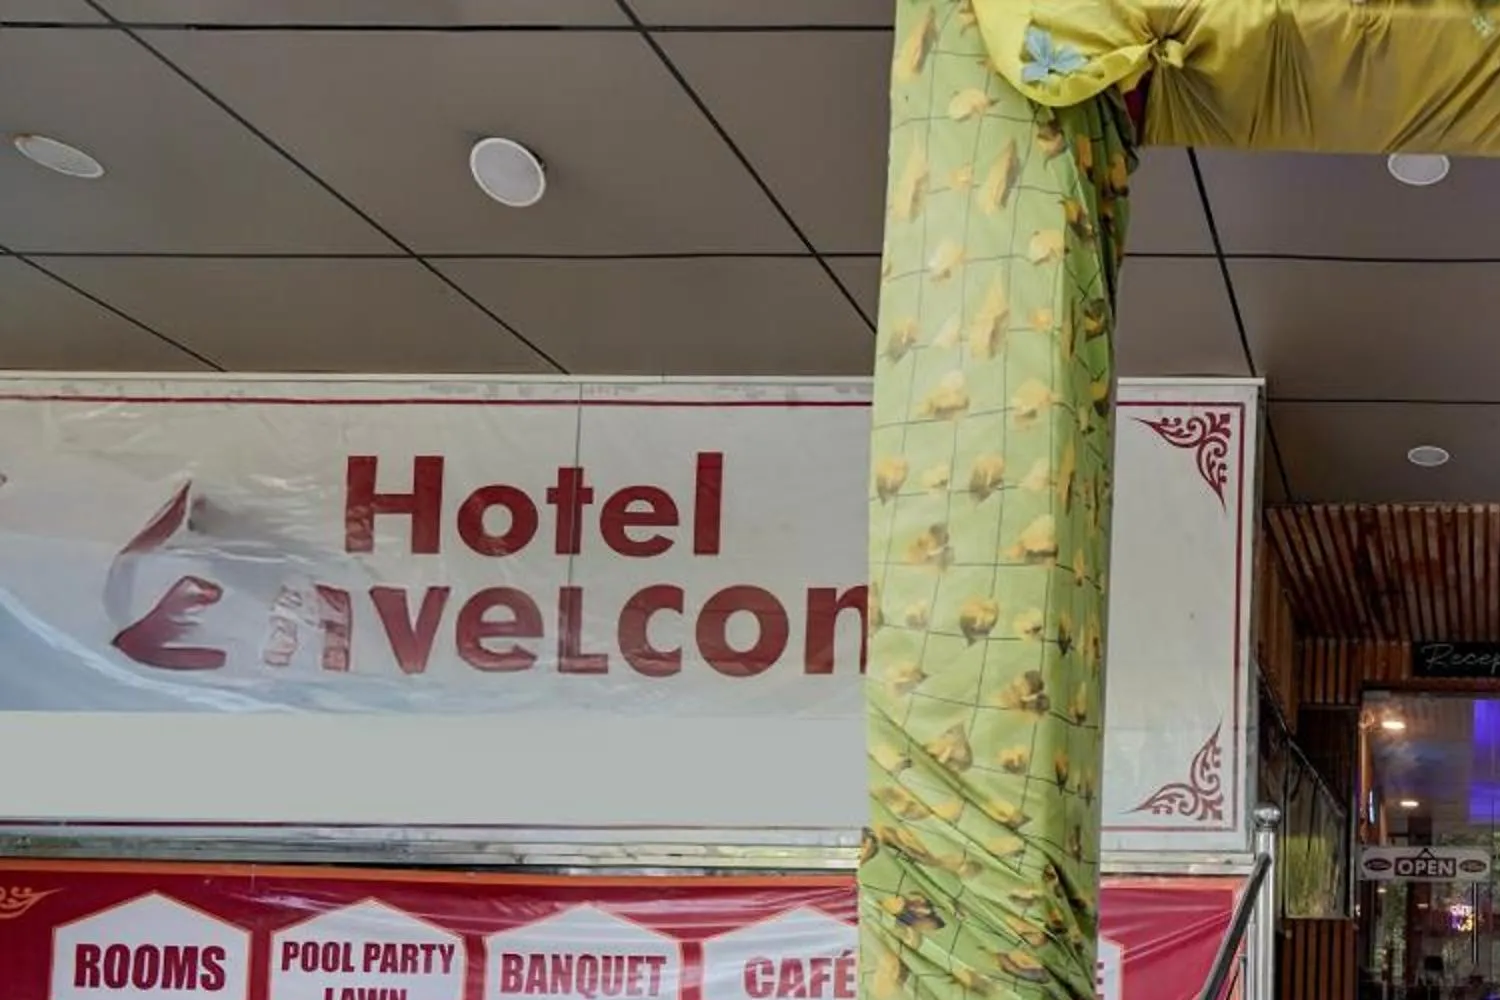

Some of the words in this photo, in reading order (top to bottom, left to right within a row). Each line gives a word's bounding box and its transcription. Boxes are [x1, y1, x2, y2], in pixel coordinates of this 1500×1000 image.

[344, 451, 724, 557] Hotel
[1397, 859, 1454, 876] OPEN
[73, 943, 227, 992] ROOMS
[281, 941, 355, 973] POOL
[362, 943, 456, 975] PARTY
[500, 952, 667, 1000] BANQUET
[743, 949, 858, 1000] CAFÉ
